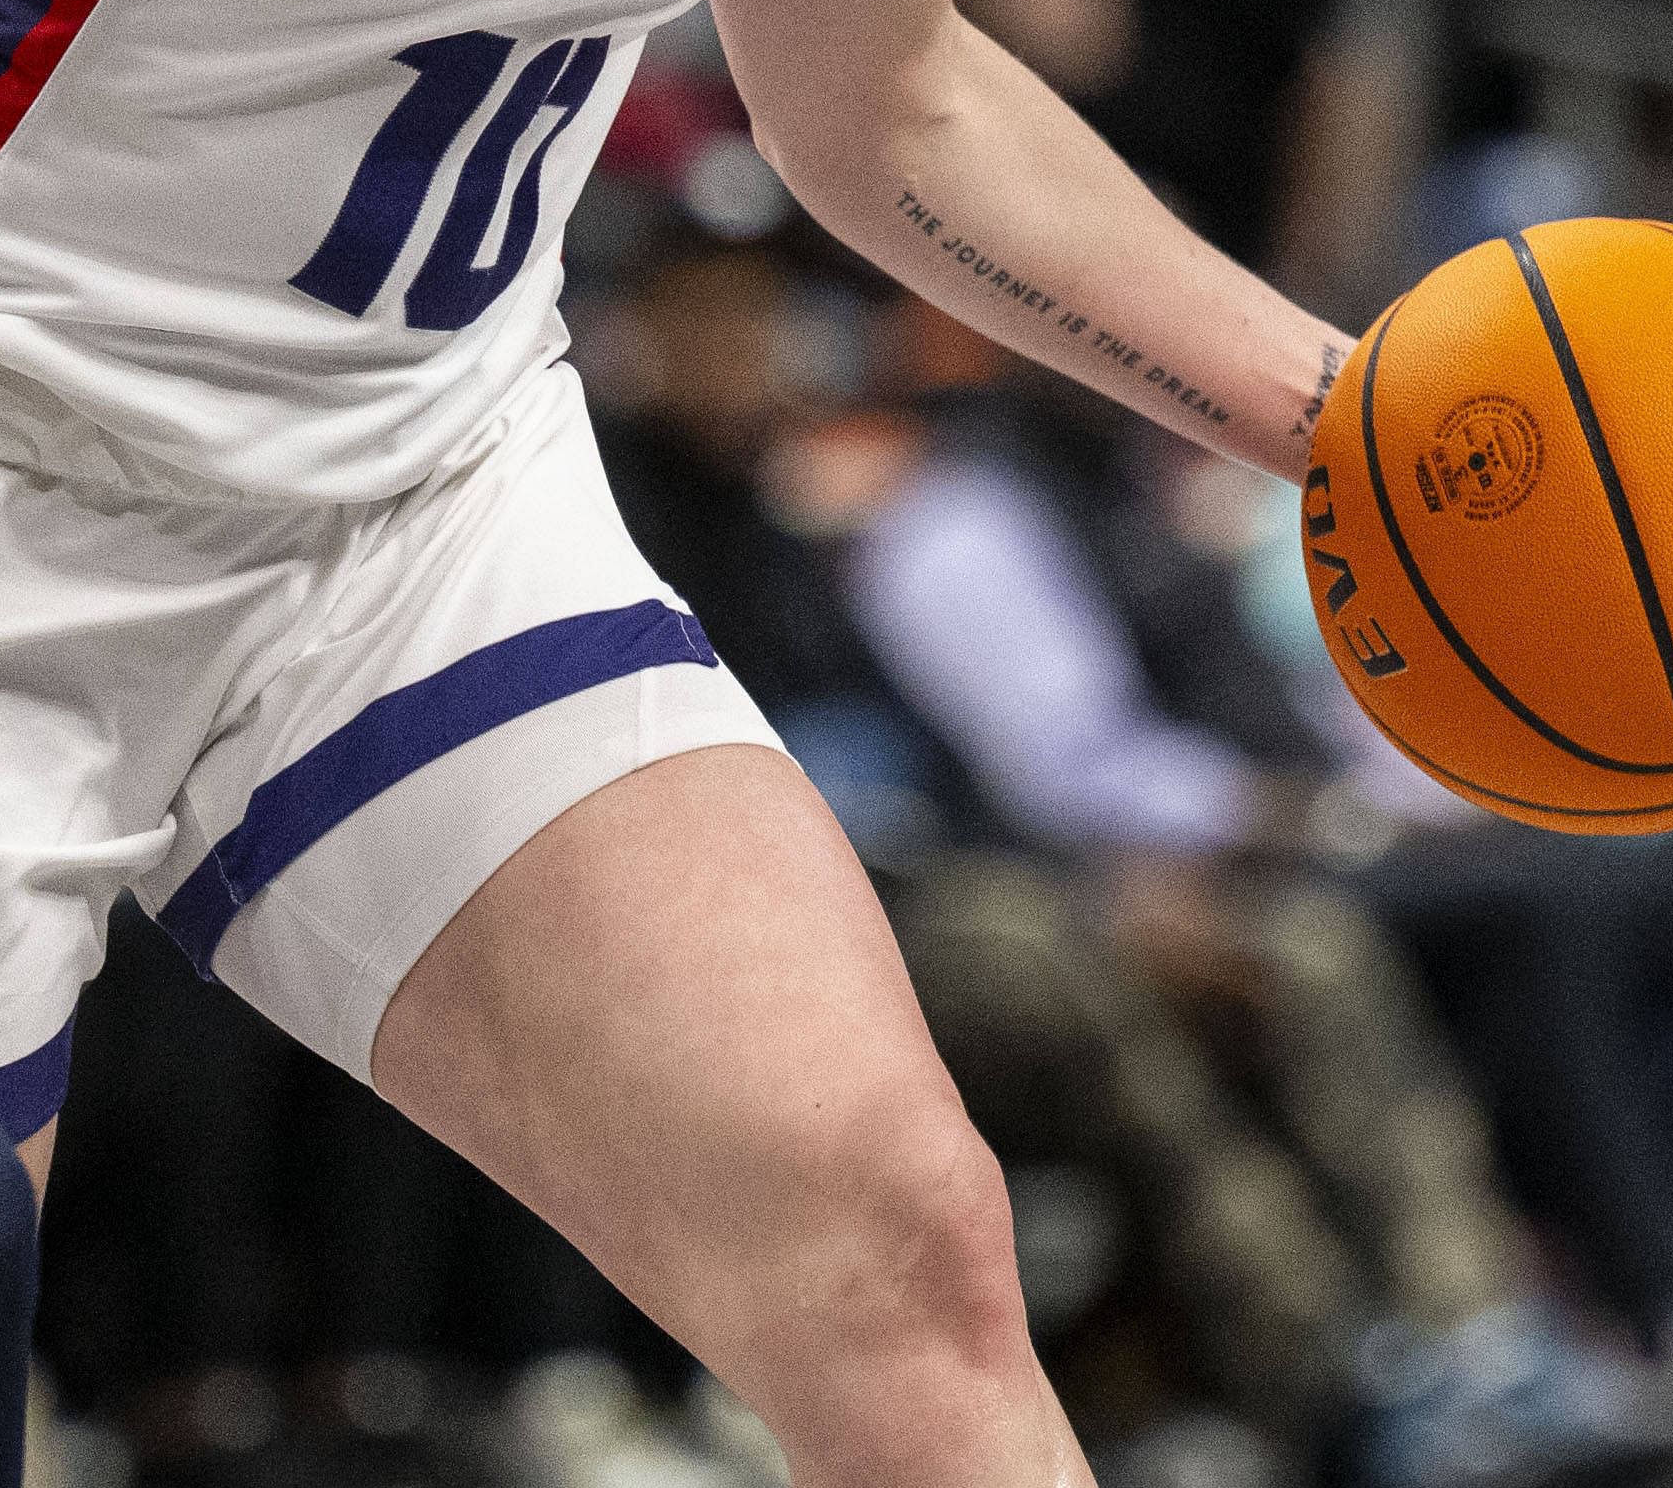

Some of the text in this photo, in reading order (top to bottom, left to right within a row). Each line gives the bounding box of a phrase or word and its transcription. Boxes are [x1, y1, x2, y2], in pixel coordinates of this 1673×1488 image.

[287, 29, 613, 331] 10
[895, 190, 943, 238] THE
[943, 233, 1057, 314] JOURNEY
[1058, 311, 1087, 336] IS
[1091, 328, 1140, 371] THE
